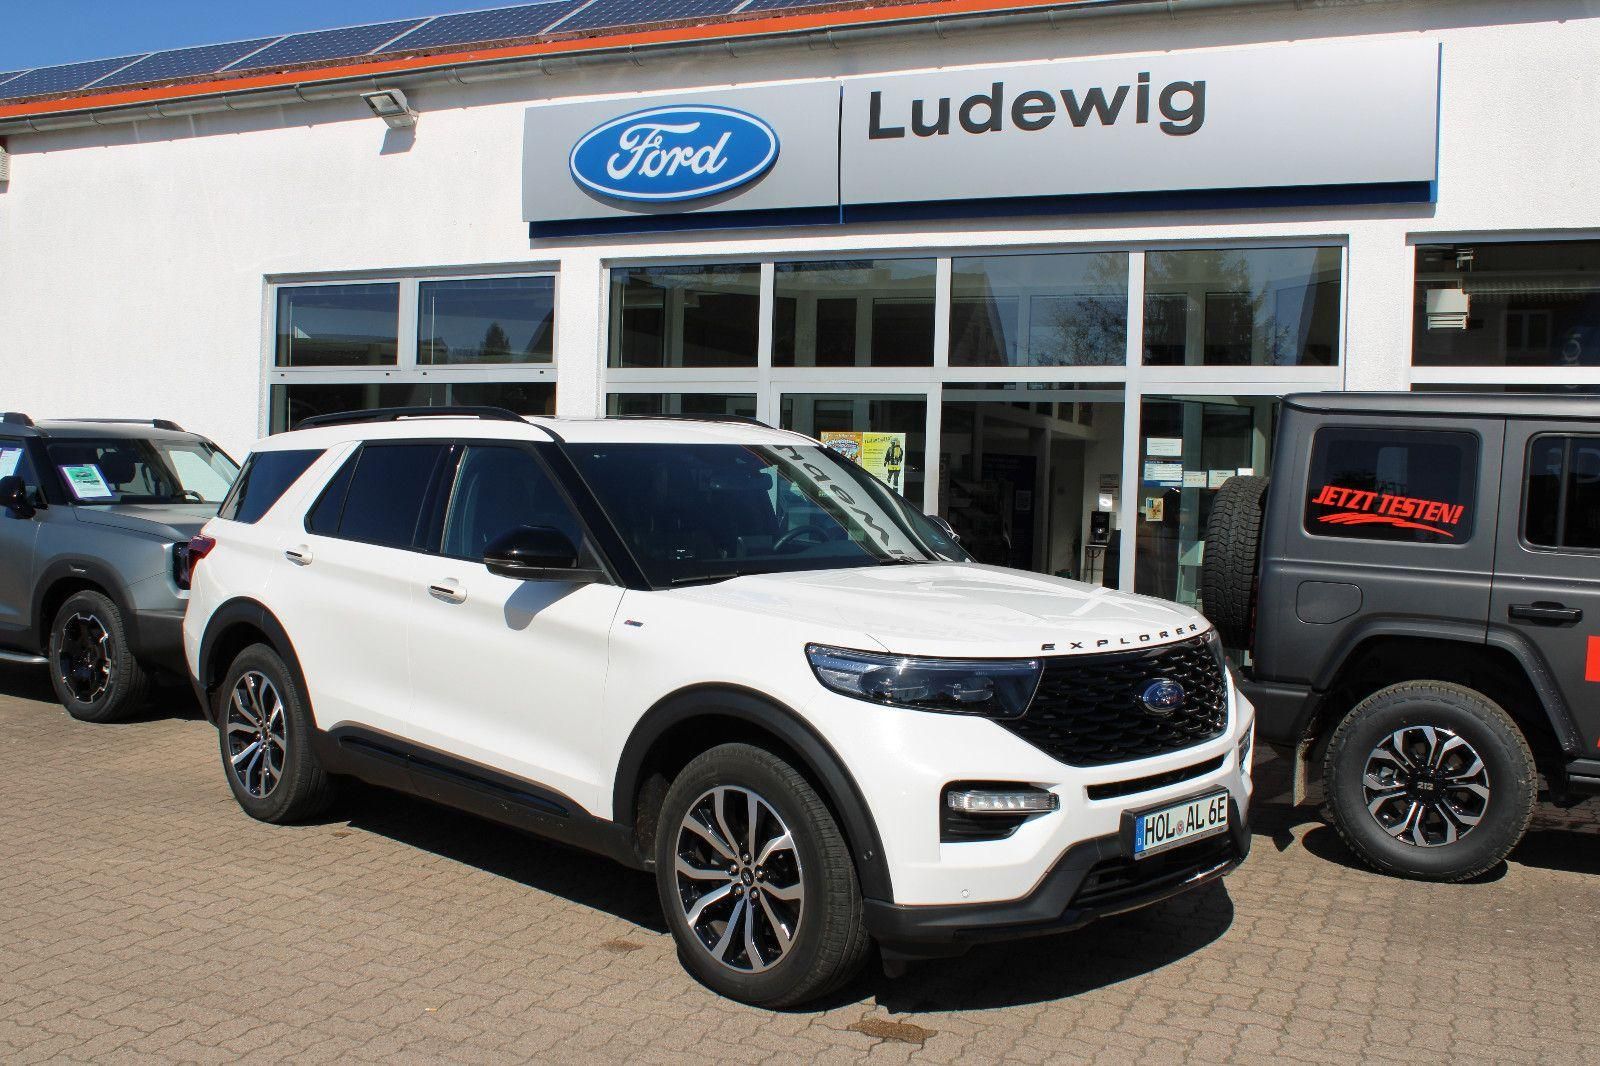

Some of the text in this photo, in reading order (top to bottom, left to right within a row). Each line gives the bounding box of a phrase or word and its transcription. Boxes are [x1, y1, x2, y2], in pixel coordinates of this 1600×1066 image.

[868, 72, 1207, 139] Ludewig
[607, 121, 728, 180] Ford
[1312, 485, 1465, 524] JETZT TESTEN!
[1041, 623, 1197, 651] EXPLORER
[1417, 781, 1434, 791] 212
[1145, 796, 1227, 846] HOL AL 6E
